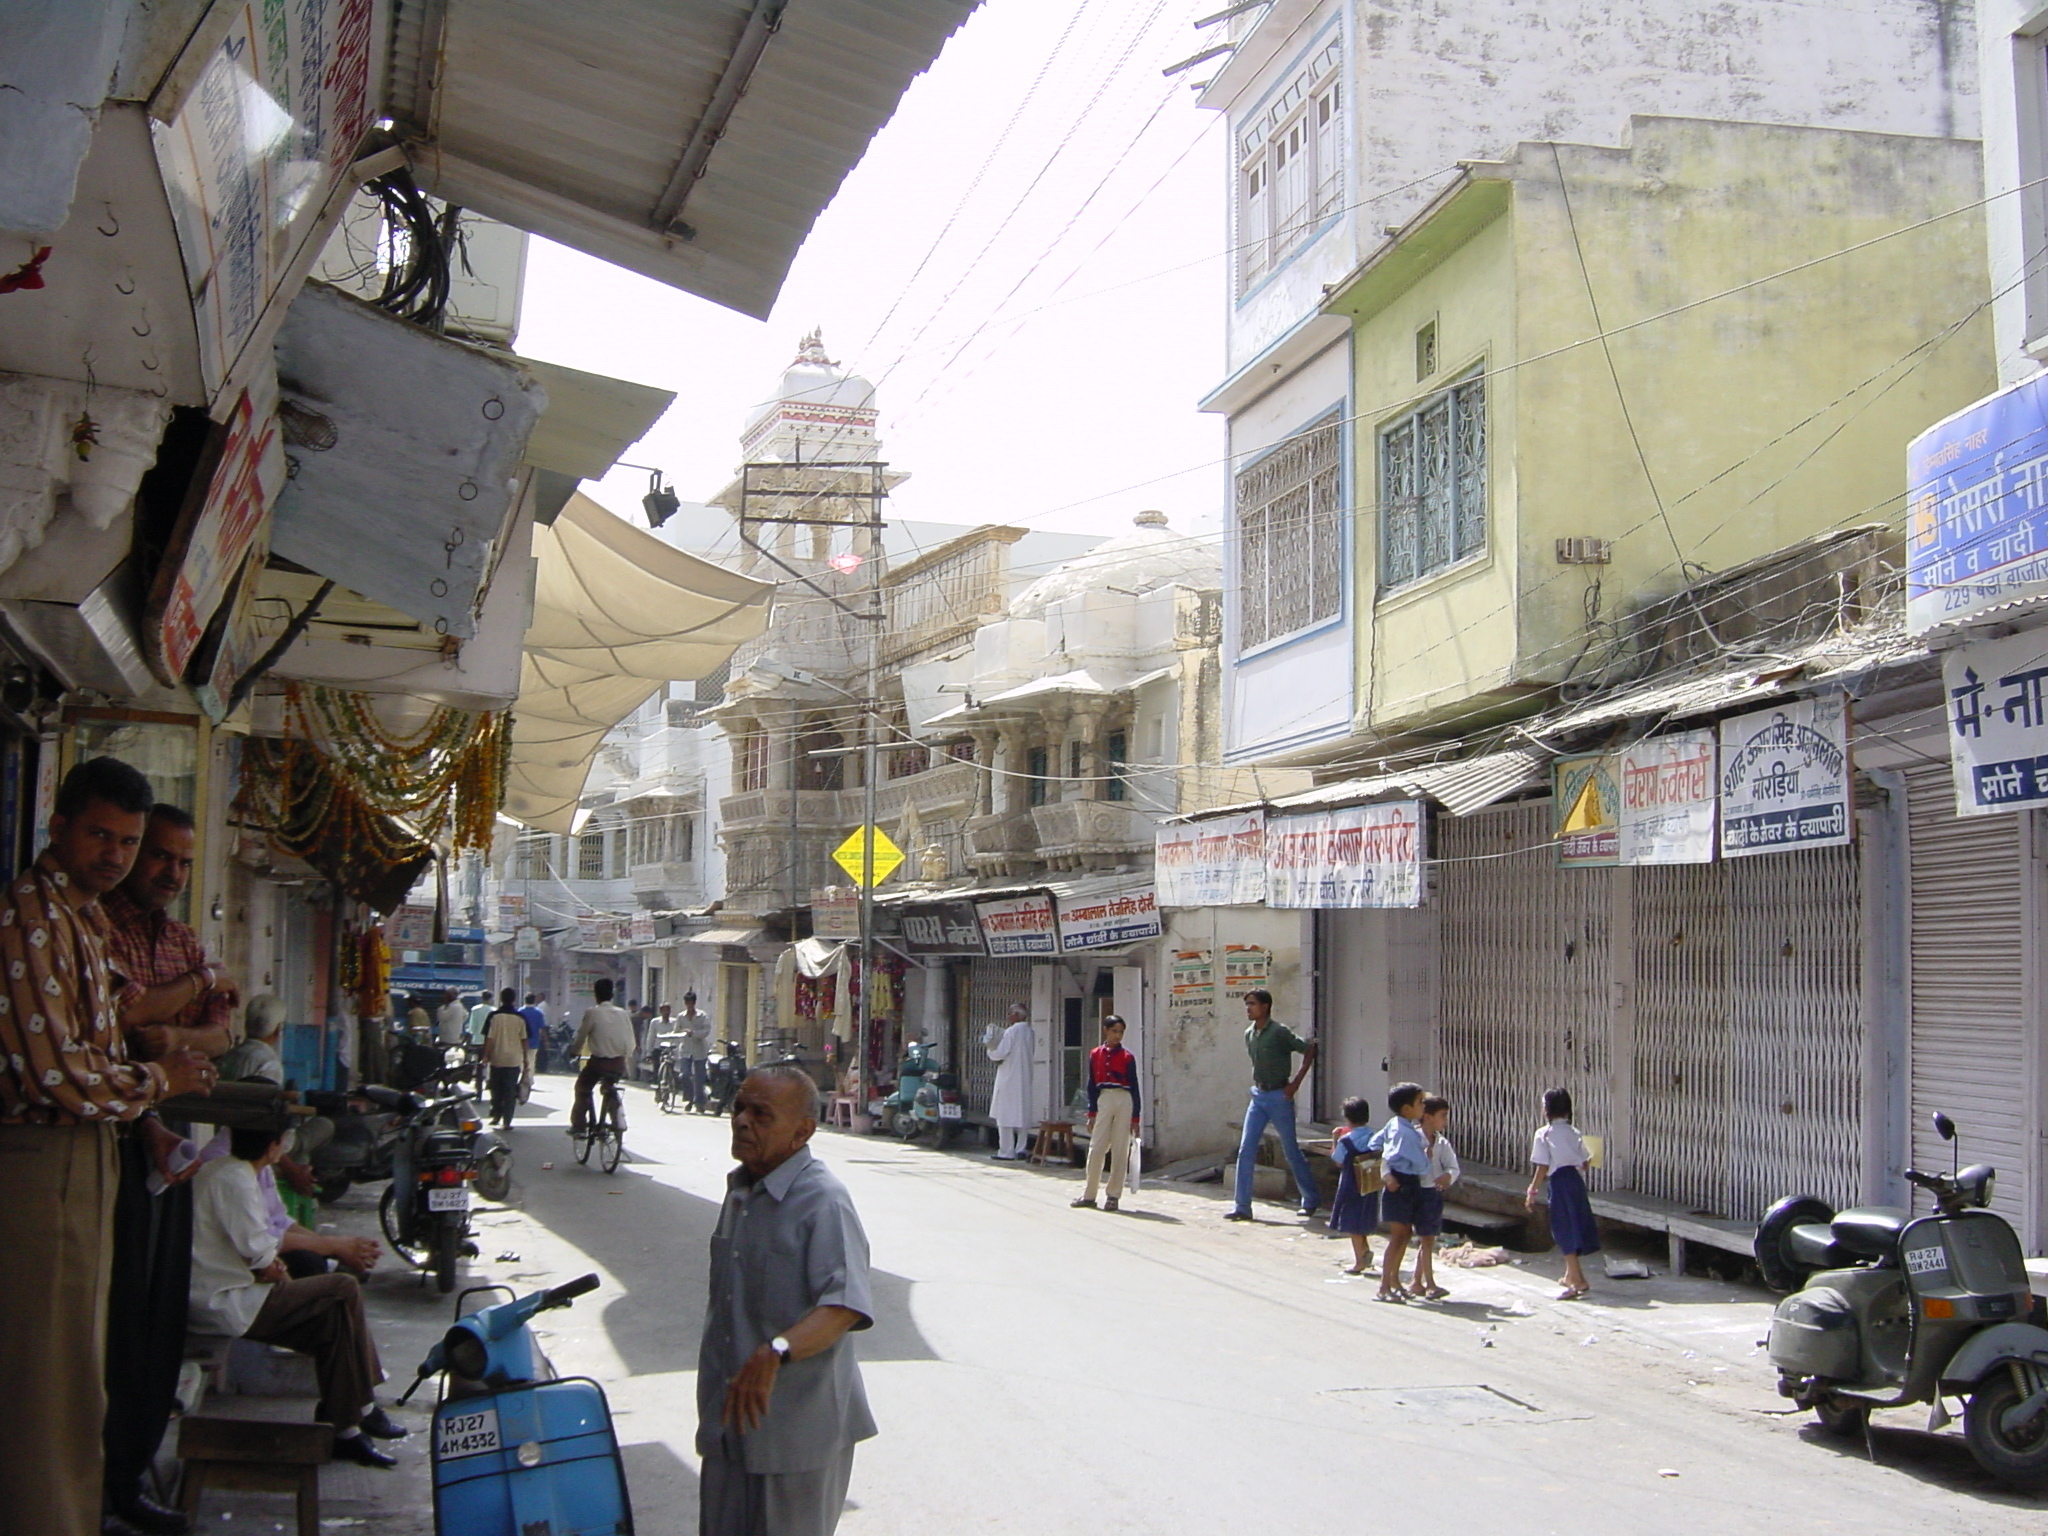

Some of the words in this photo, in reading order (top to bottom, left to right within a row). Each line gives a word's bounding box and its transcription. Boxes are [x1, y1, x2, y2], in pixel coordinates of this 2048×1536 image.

[1944, 587, 1970, 612] 229
[1785, 815, 1798, 838] के
[1799, 805, 1844, 835] व्यापारी
